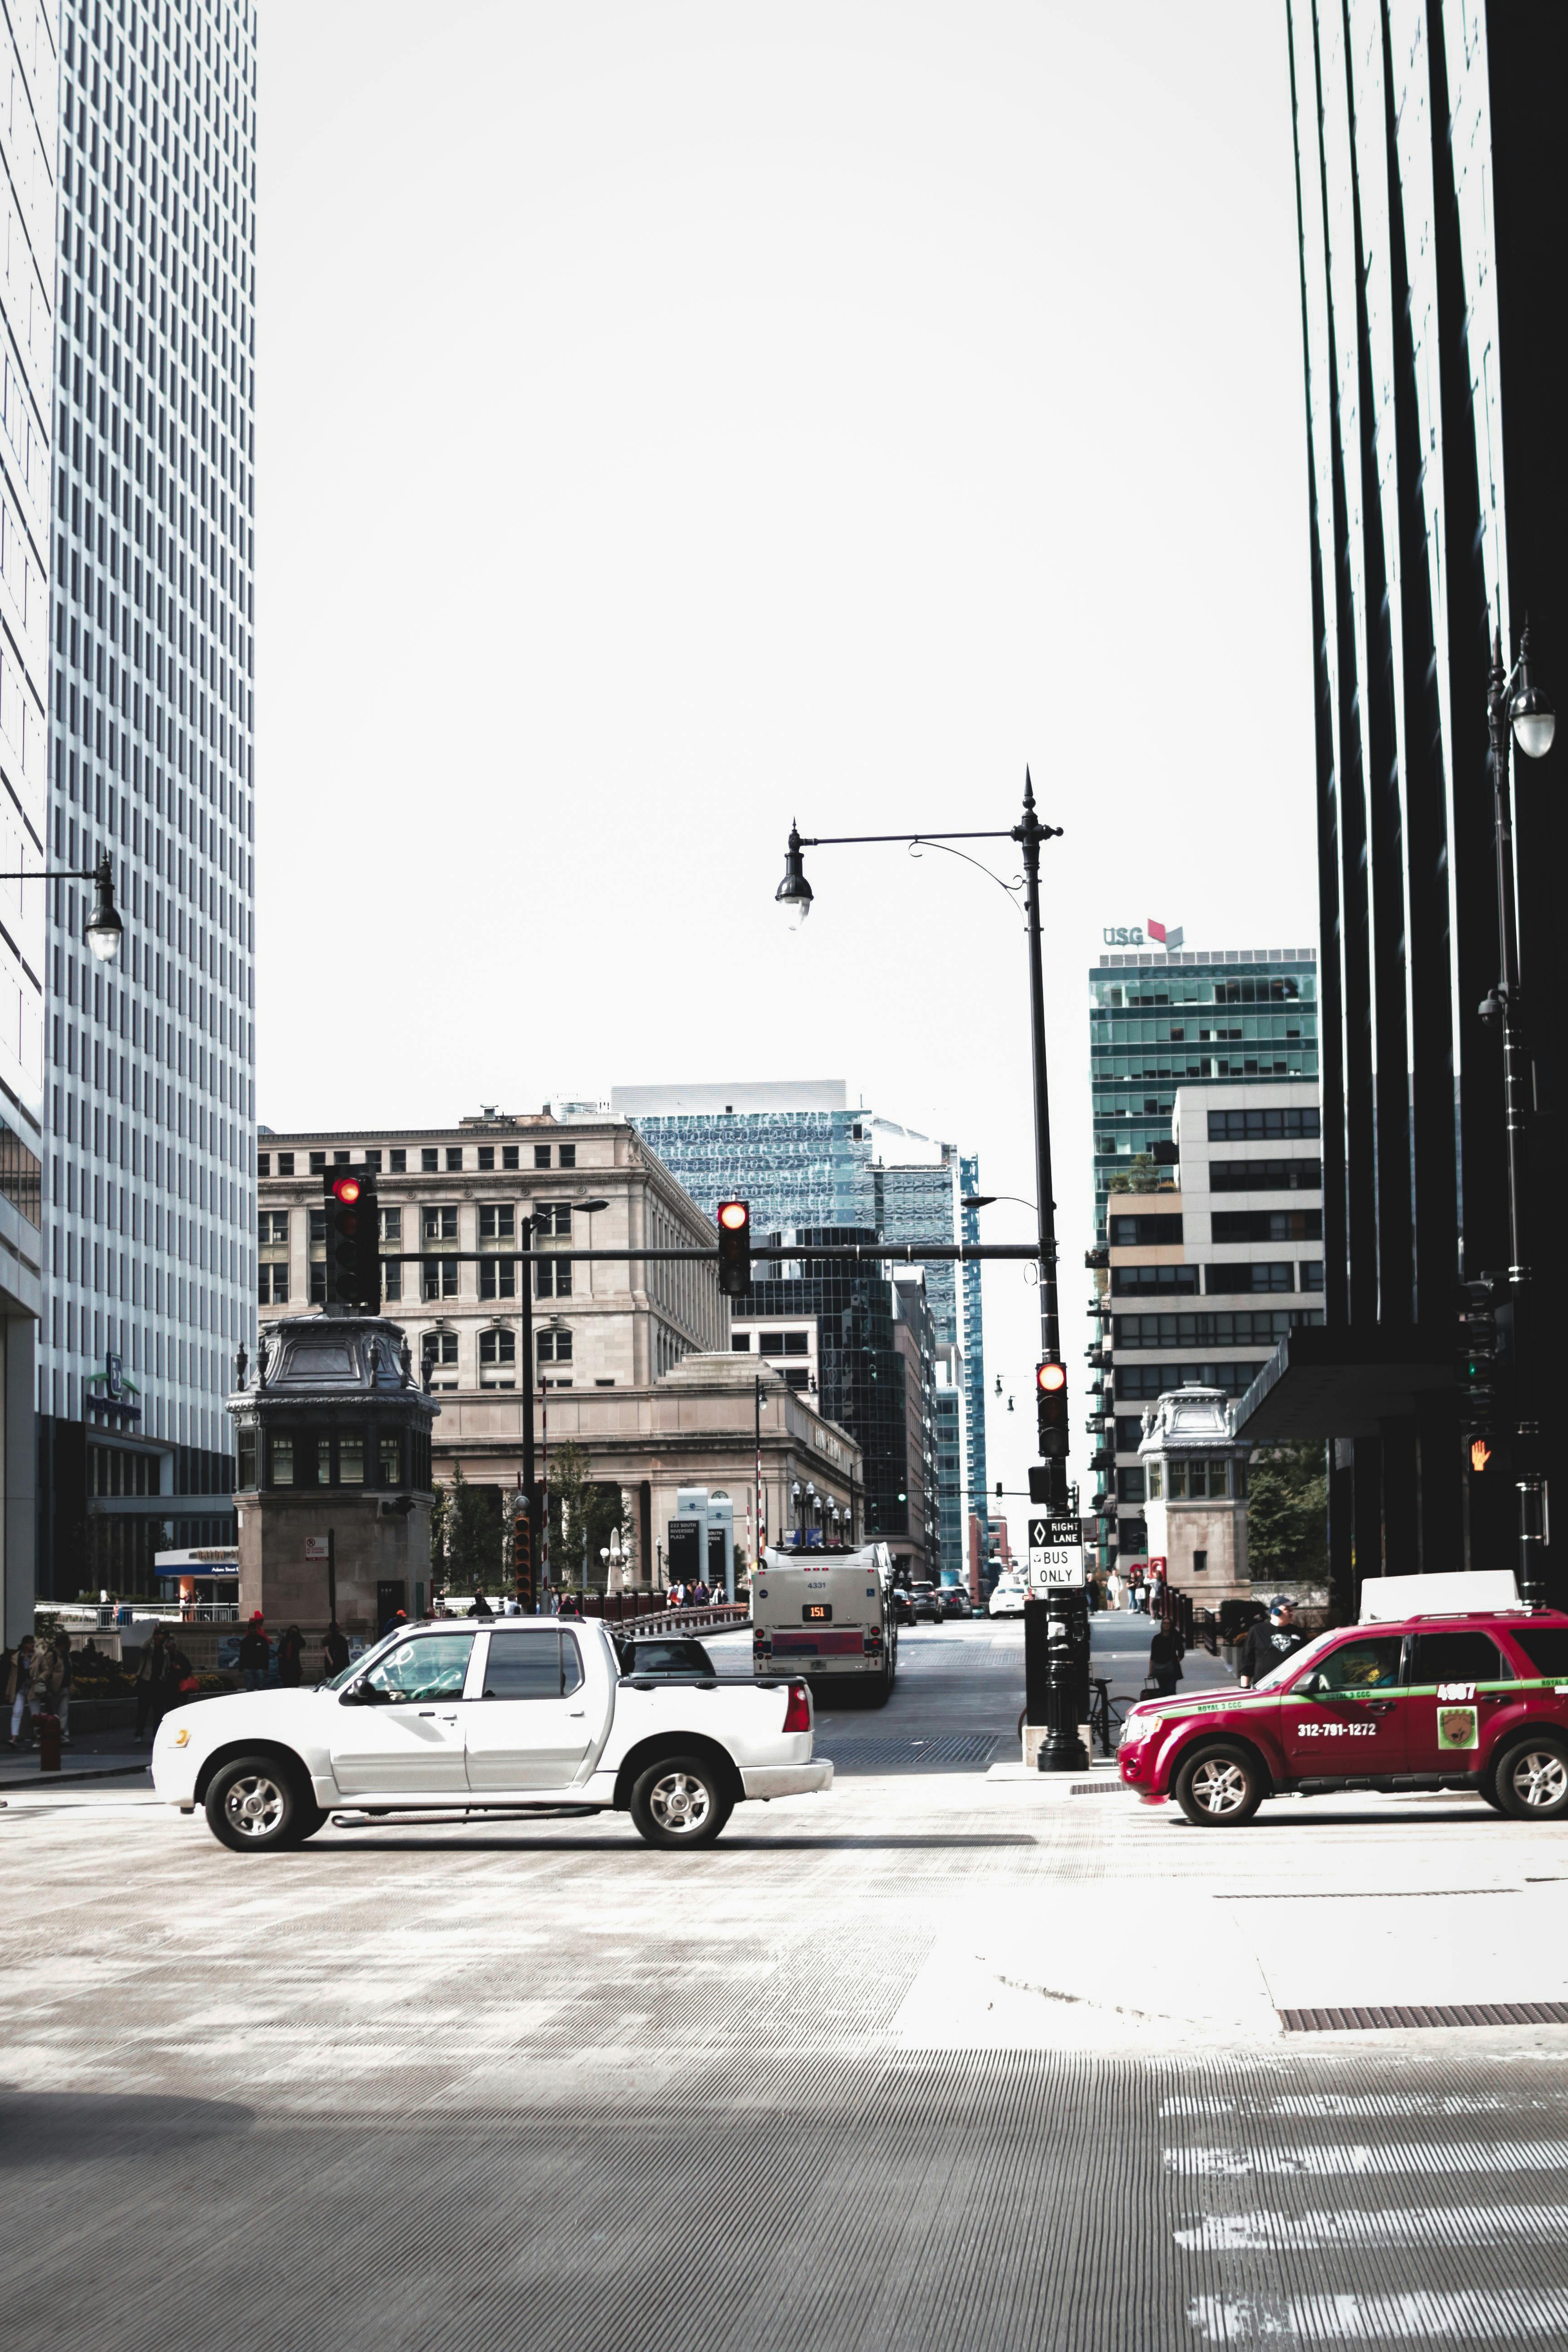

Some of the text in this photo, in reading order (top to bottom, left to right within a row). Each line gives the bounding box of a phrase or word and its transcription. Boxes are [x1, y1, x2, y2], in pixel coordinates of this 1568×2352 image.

[1103, 927, 1143, 946] USG
[1051, 1523, 1079, 1531] RIGHT
[1054, 1534, 1078, 1543] LANE
[197, 1550, 225, 1560] UNION
[1044, 1551, 1068, 1564] BUS
[1040, 1569, 1072, 1582] ONLY
[810, 1607, 824, 1617] 151
[1298, 1723, 1377, 1736] 312-791-1272
